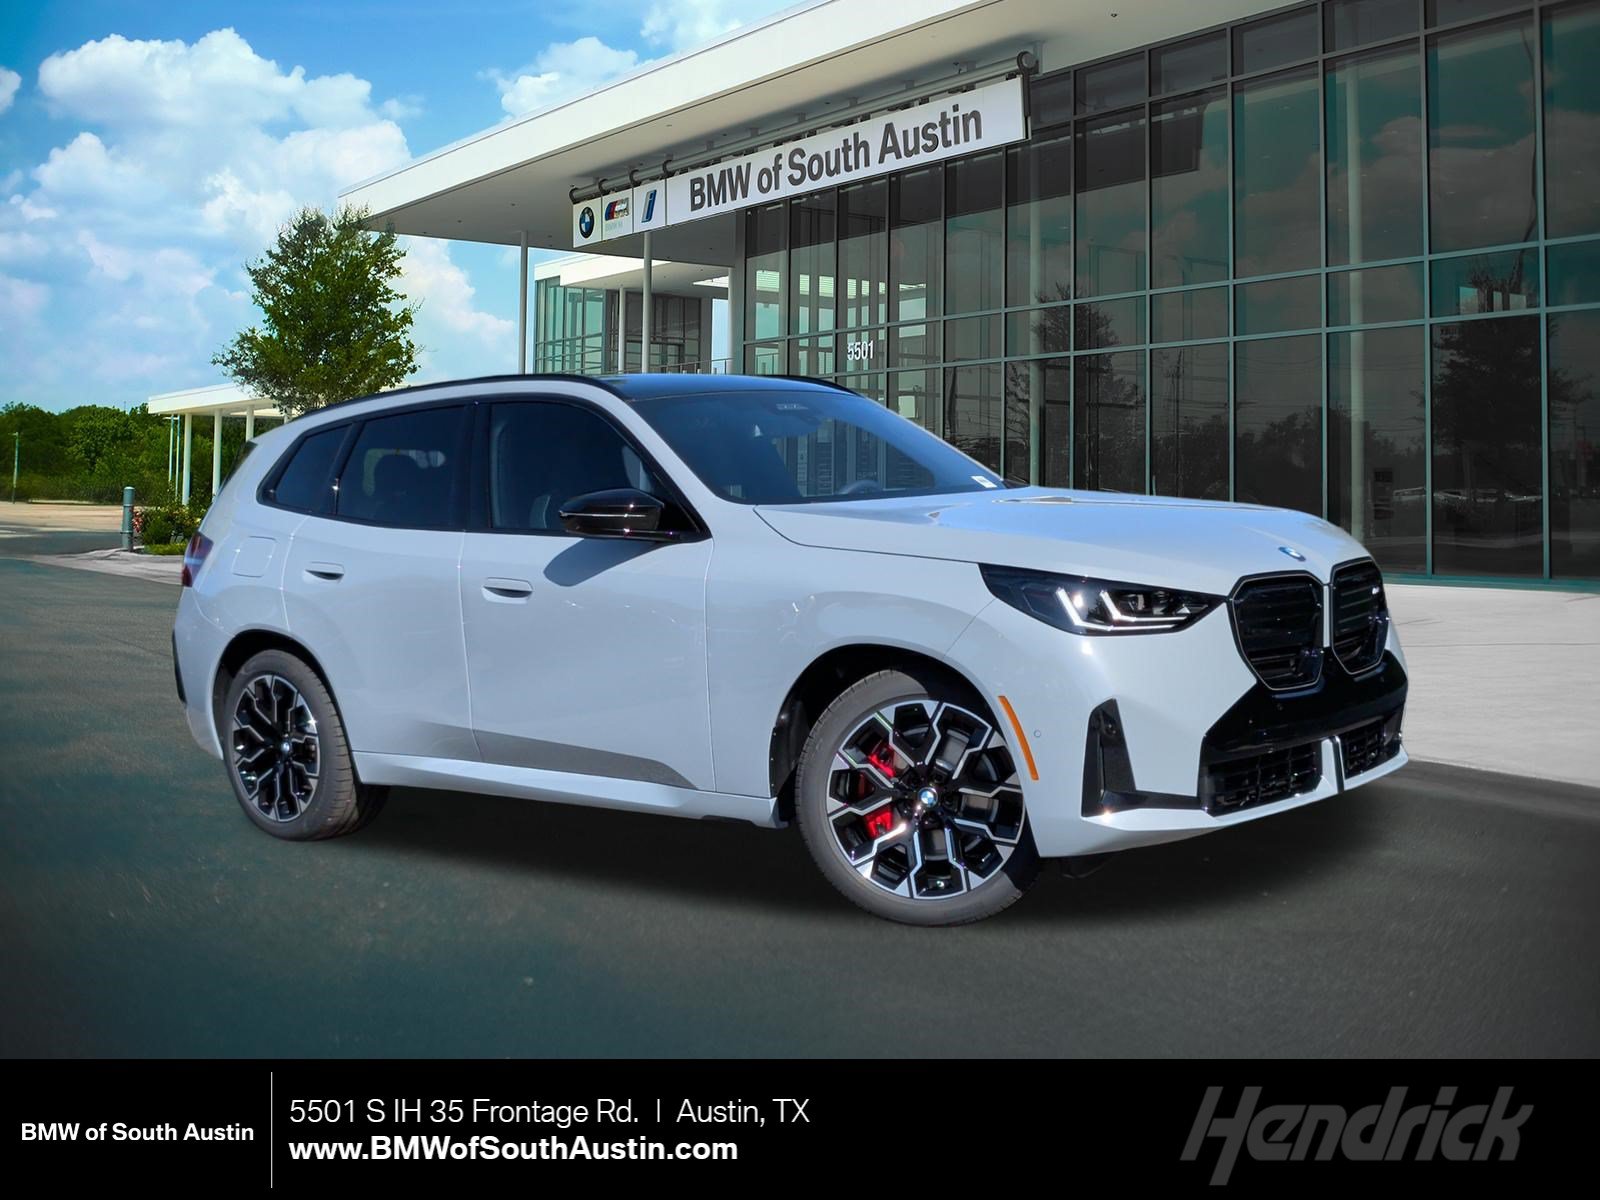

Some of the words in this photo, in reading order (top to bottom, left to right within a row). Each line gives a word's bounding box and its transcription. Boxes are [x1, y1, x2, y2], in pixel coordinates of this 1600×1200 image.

[689, 162, 752, 212] BMW
[757, 153, 782, 194] of
[787, 132, 871, 187] South
[878, 104, 982, 165] Austin
[847, 340, 874, 360] 5501
